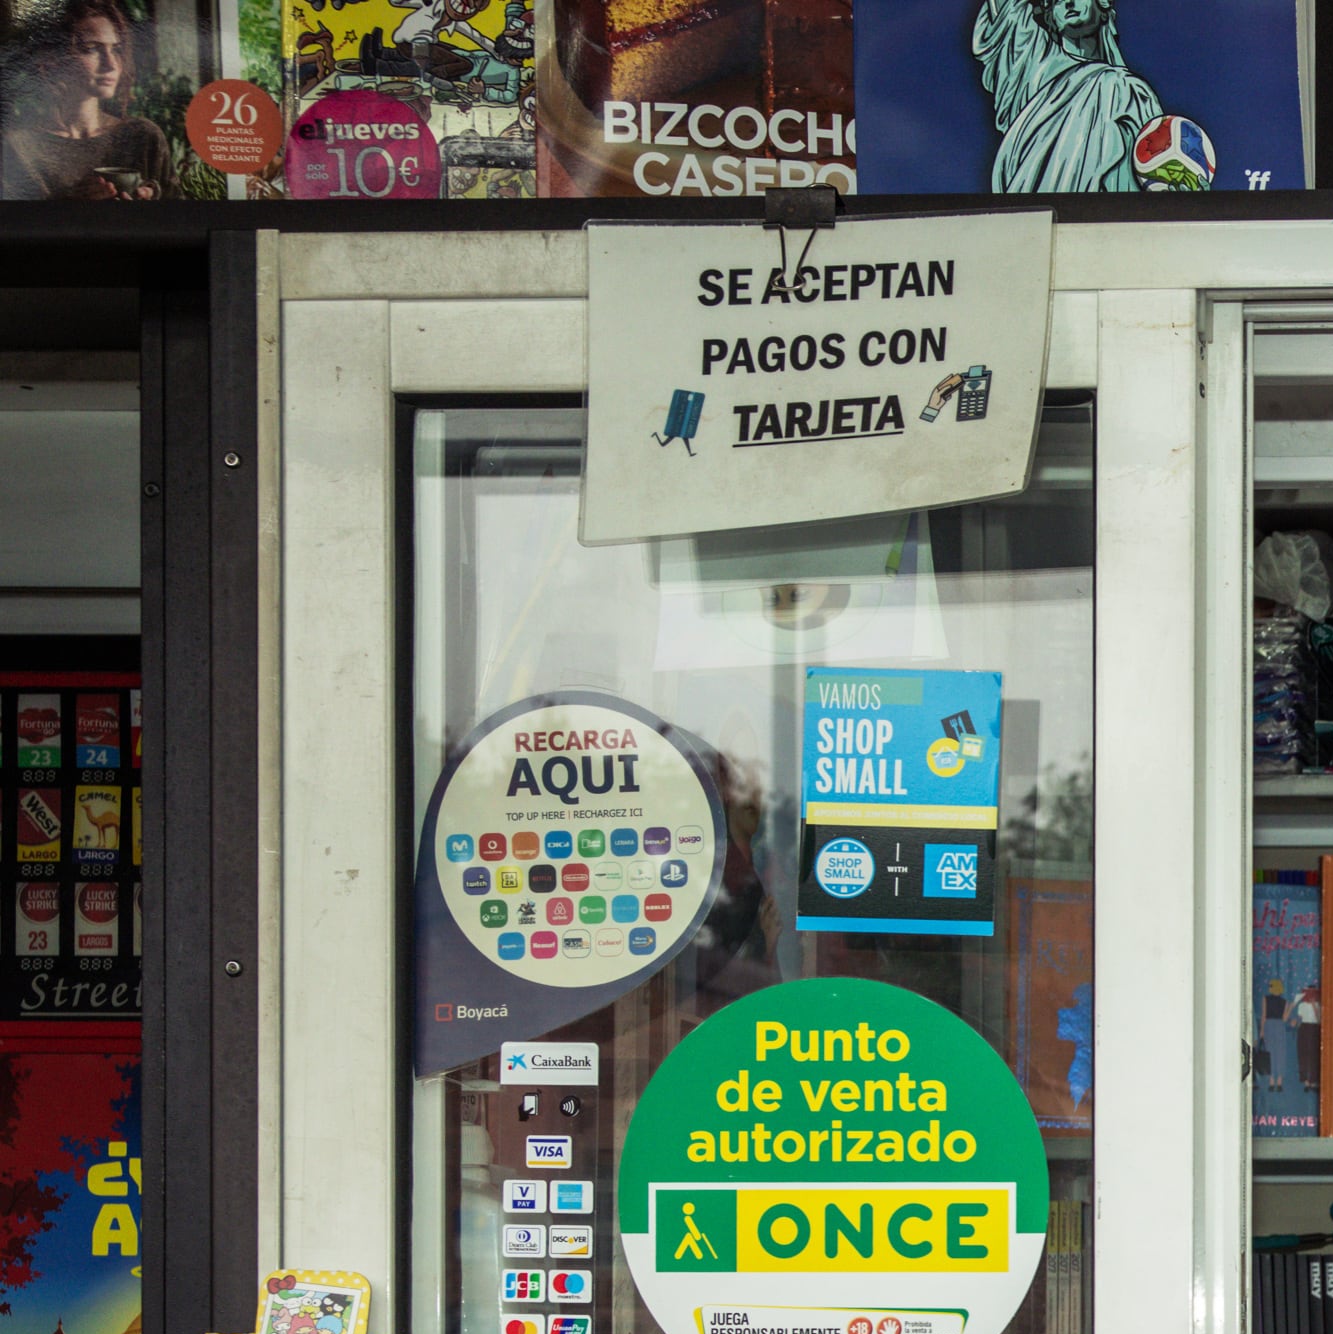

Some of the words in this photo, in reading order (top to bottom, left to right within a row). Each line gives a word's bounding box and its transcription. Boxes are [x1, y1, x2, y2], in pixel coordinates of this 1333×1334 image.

[210, 92, 258, 126] 26
[215, 127, 256, 136] PLANTAS
[697, 269, 753, 306] SE
[762, 260, 956, 304] ACEPTAN
[702, 334, 845, 375] PAGOS
[858, 327, 947, 367] CON
[732, 395, 905, 443] TARJETA
[818, 683, 882, 711] VAMOS
[514, 729, 637, 753] RECARGA
[816, 719, 893, 754] SHOP
[86, 749, 107, 766] 24
[506, 754, 640, 804] AQUI
[815, 758, 908, 795] SMALL
[506, 811, 527, 822] TOP
[529, 811, 541, 821] UP
[543, 811, 566, 820] HERE
[573, 809, 626, 820] RECHARGEZ
[628, 809, 643, 818] ICI
[457, 1004, 508, 1020] Boyacá
[755, 1021, 911, 1062] Punto
[531, 1054, 592, 1070] CaixaBank
[716, 1070, 781, 1112] de
[802, 1079, 947, 1112] venta
[533, 1146, 564, 1158] VISA
[686, 1121, 977, 1163] autorizado
[757, 1203, 989, 1259] ONCE
[710, 1312, 750, 1326] JUEGA
